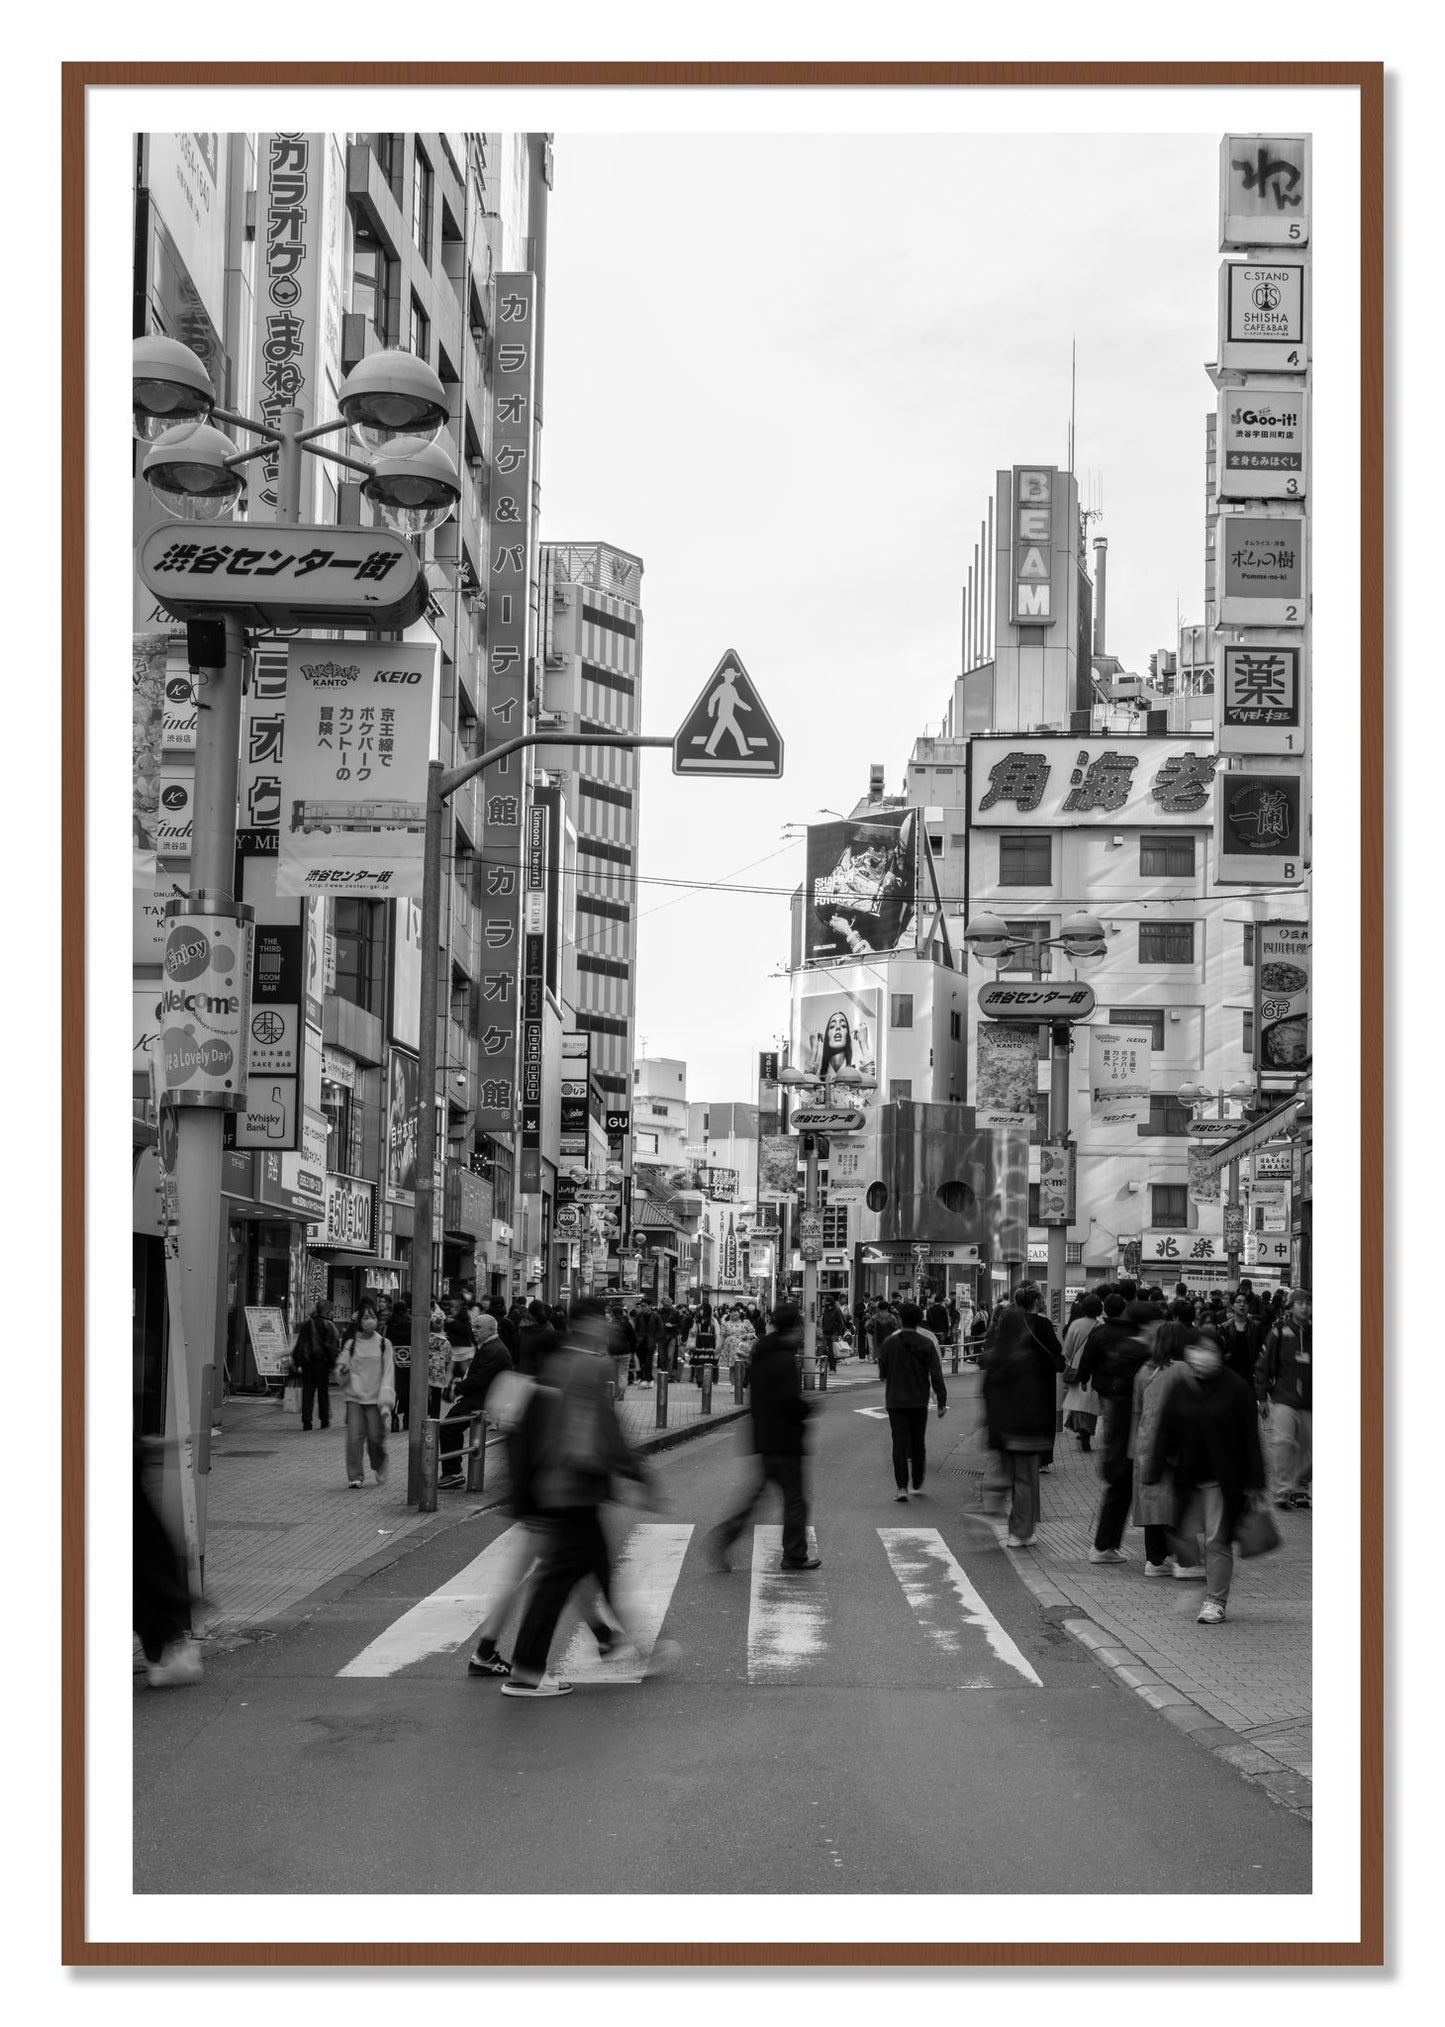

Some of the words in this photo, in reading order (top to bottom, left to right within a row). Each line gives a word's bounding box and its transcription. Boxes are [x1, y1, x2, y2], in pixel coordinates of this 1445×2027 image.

[267, 139, 310, 277] カラオケ
[1288, 224, 1302, 240] 5
[1243, 271, 1290, 282] C.STAND
[1243, 312, 1289, 323] SHISHA
[1243, 323, 1289, 332] CAFE&BAR
[1287, 351, 1300, 367] 4
[1242, 409, 1298, 427] Goo-it!
[1235, 430, 1294, 440] 渋谷宇田川町店
[1230, 455, 1298, 467] 全身もみほぐし
[1286, 478, 1299, 494] 3
[1018, 471, 1050, 616] BEAM
[153, 543, 403, 582] 渋谷センター街
[1285, 605, 1298, 621] 2
[313, 678, 349, 687] KANTO
[373, 669, 423, 685] KEIO
[1234, 654, 1286, 706] 薬
[1228, 708, 1291, 723] マツモトキヨシ
[317, 706, 334, 750] 冒険へ
[166, 733, 192, 744] 渋谷店
[336, 706, 354, 781] カントーの
[378, 707, 395, 768] 京王線で
[1285, 734, 1294, 750] 1
[978, 750, 1219, 813] 角海老
[1229, 790, 1290, 838] 一蘭
[532, 810, 542, 847] kimono
[162, 841, 188, 851] 渋谷店
[305, 869, 395, 883] 渋谷センター街
[1284, 862, 1296, 879] B
[263, 937, 278, 945] THE
[166, 938, 207, 975] Enjoy
[259, 973, 280, 981] ROOM
[262, 984, 277, 992] BAR
[162, 989, 240, 1015] Welcome
[985, 991, 1088, 1004] 渋谷センター街
[1262, 1000, 1290, 1020] 6F
[180, 1047, 210, 1068] Lovely
[211, 1048, 232, 1064] Day!
[246, 1113, 280, 1125] Whisky
[608, 1116, 629, 1128] GU
[794, 1114, 857, 1123] 渋谷センター街
[246, 1122, 267, 1132] Bank
[726, 1234, 737, 1277] BEER
